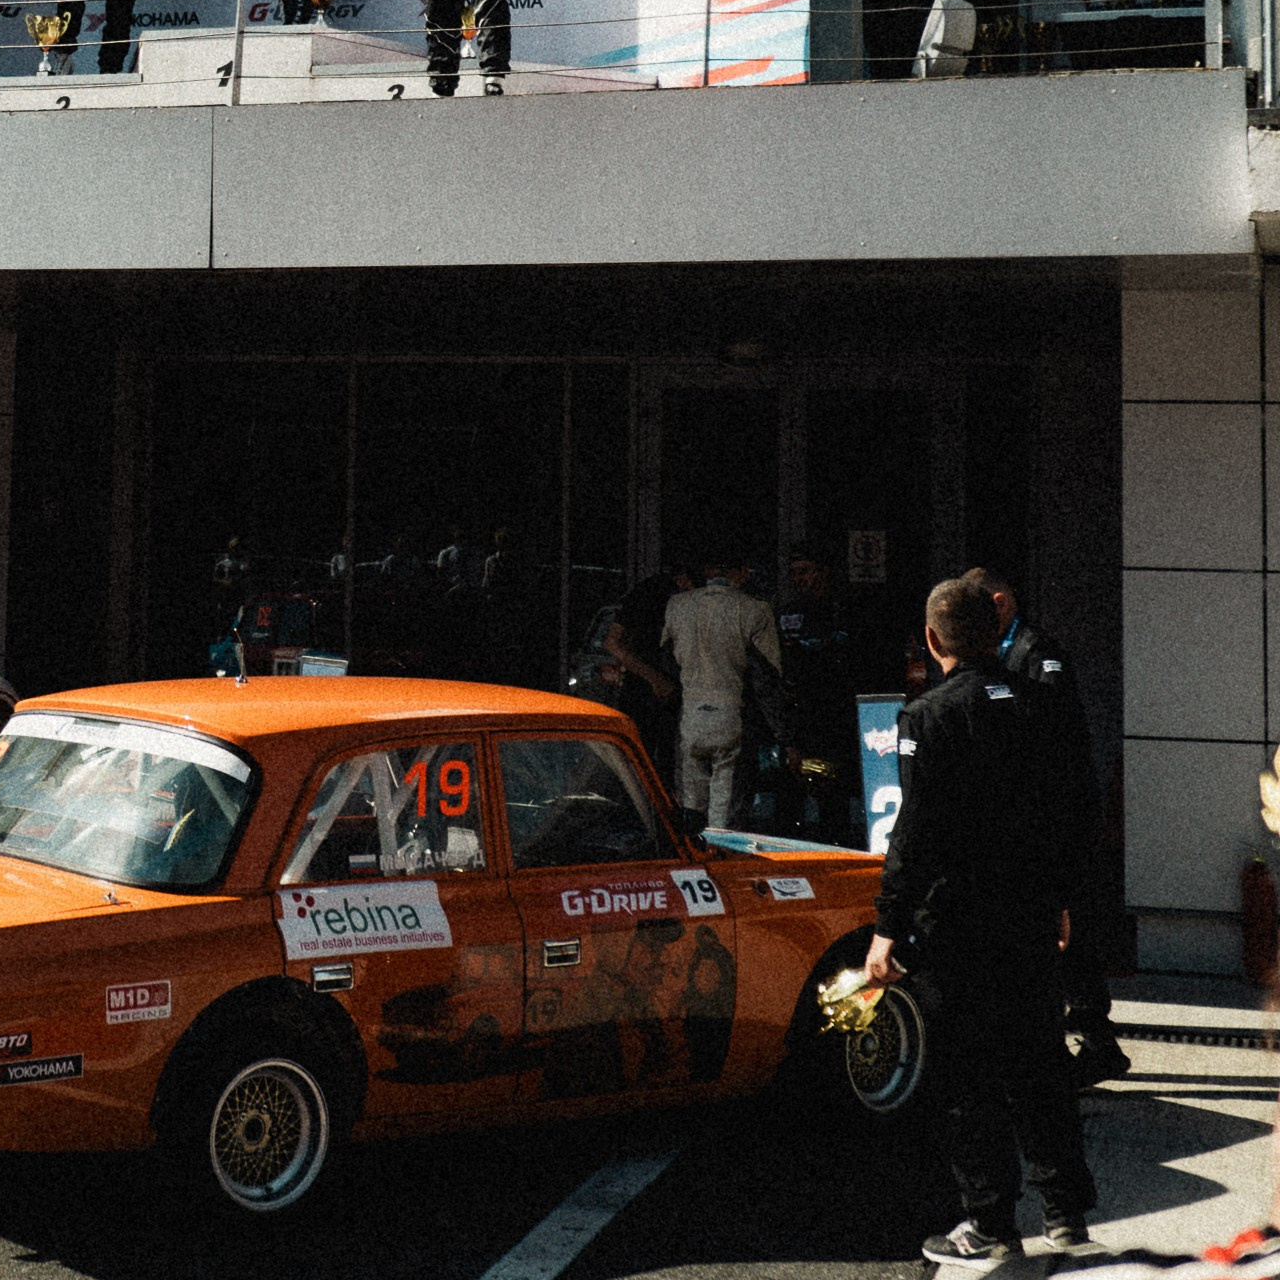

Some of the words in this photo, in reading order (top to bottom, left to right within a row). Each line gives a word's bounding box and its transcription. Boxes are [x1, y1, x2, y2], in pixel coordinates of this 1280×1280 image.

[132, 11, 200, 27] KOHAMA
[216, 61, 234, 87] 1
[403, 760, 470, 817] 19
[871, 786, 903, 855] 2
[608, 879, 666, 890] ТОПЛИВО
[681, 879, 716, 903] 19
[310, 897, 421, 936] rebina
[299, 939, 319, 951] real
[322, 937, 353, 948] estate
[355, 933, 399, 946] business
[400, 930, 445, 944] initiatives
[109, 988, 151, 1009] M1D
[109, 1009, 168, 1021] RACING
[7, 1060, 75, 1080] YOKOHAMA
